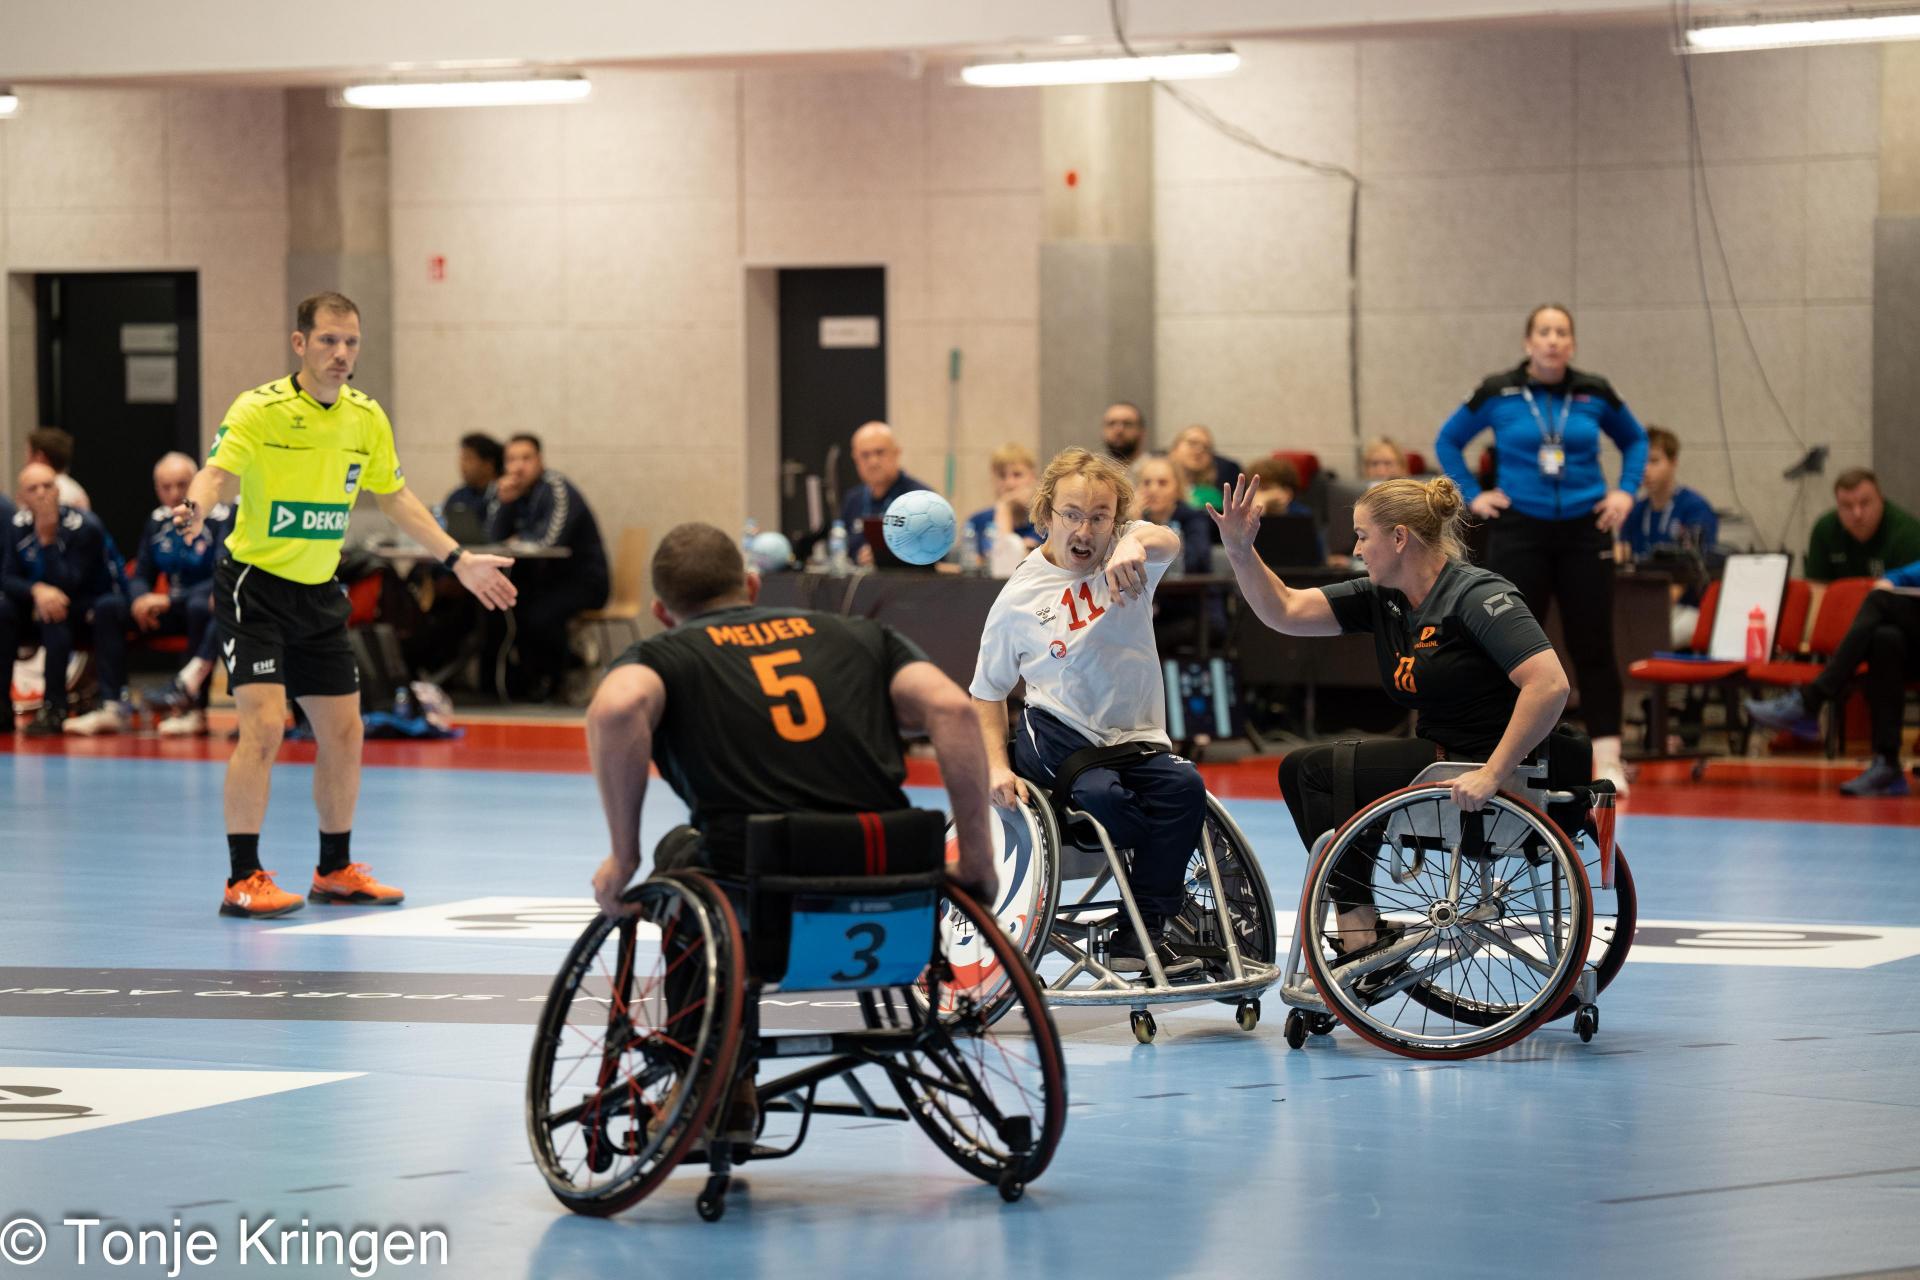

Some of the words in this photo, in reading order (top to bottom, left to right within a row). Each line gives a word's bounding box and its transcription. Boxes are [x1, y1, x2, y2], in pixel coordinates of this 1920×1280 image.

[1061, 582, 1106, 631] 11
[705, 617, 816, 647] MEIJER
[252, 659, 276, 673] EHF
[749, 648, 827, 742] 5
[831, 922, 886, 982] 3
